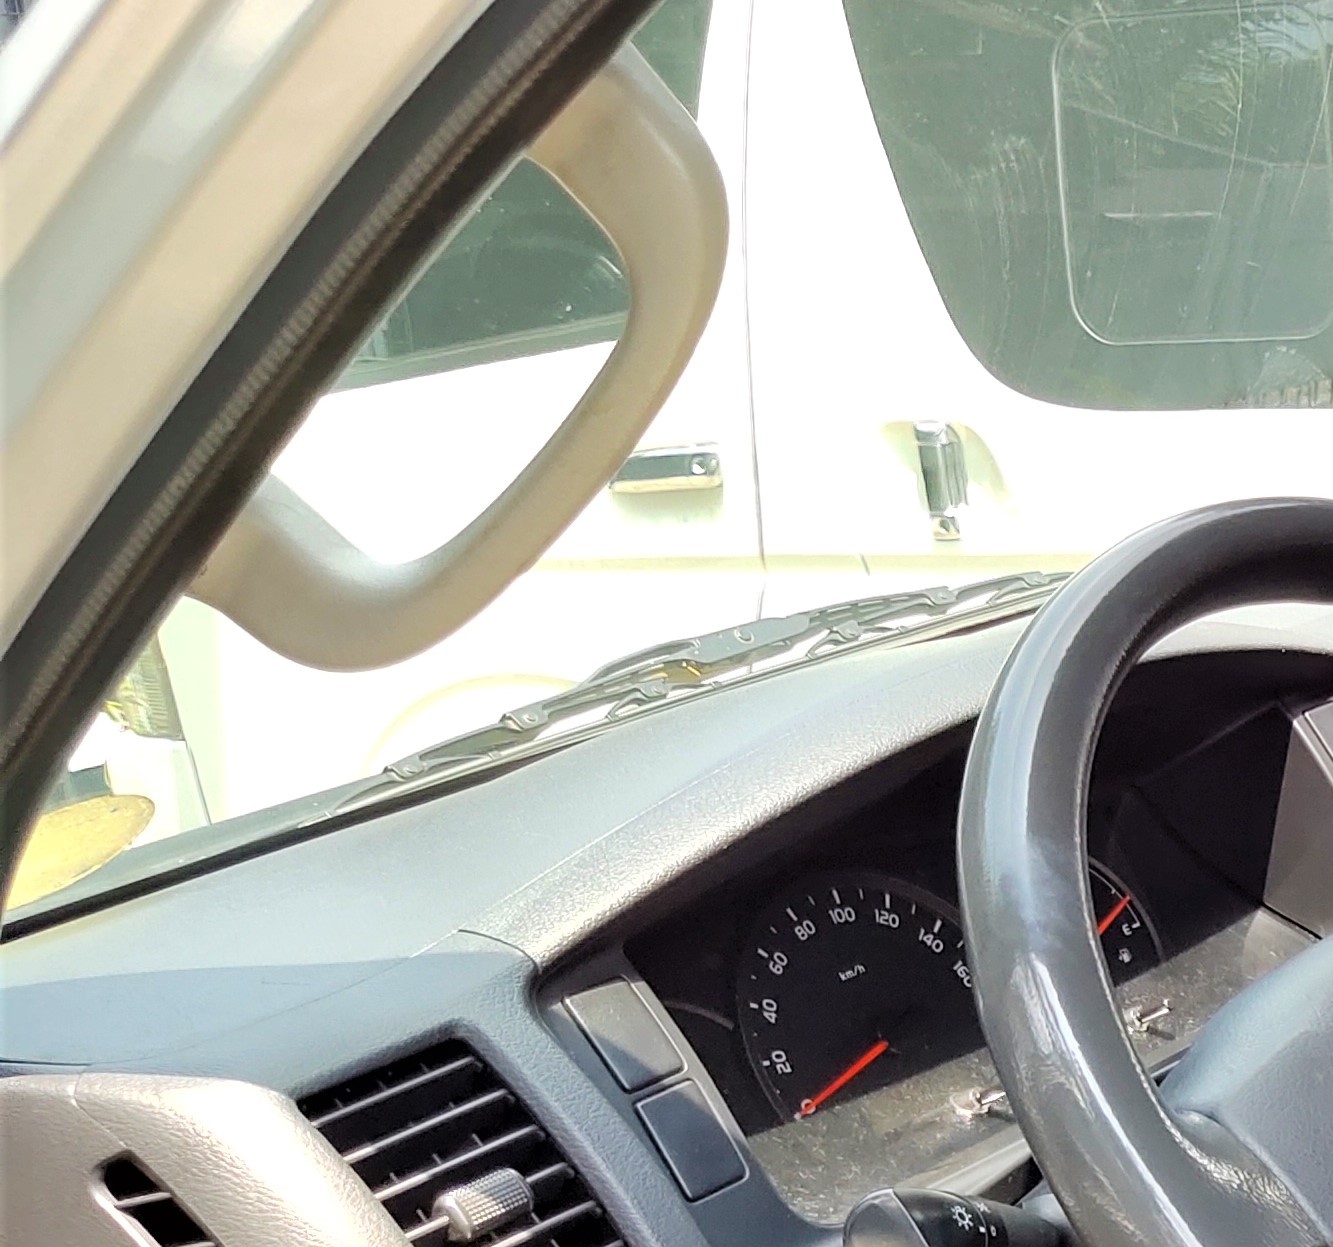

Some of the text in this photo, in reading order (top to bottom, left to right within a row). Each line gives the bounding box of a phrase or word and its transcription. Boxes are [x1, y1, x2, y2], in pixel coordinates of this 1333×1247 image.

[828, 906, 856, 924] 100
[874, 908, 900, 929] 120
[794, 919, 816, 941] 80
[918, 927, 944, 953] 140
[1121, 923, 1133, 937] E
[768, 951, 789, 976] 60
[838, 963, 867, 982] km/h
[762, 998, 778, 1024] 40
[771, 1049, 793, 1075] 20
